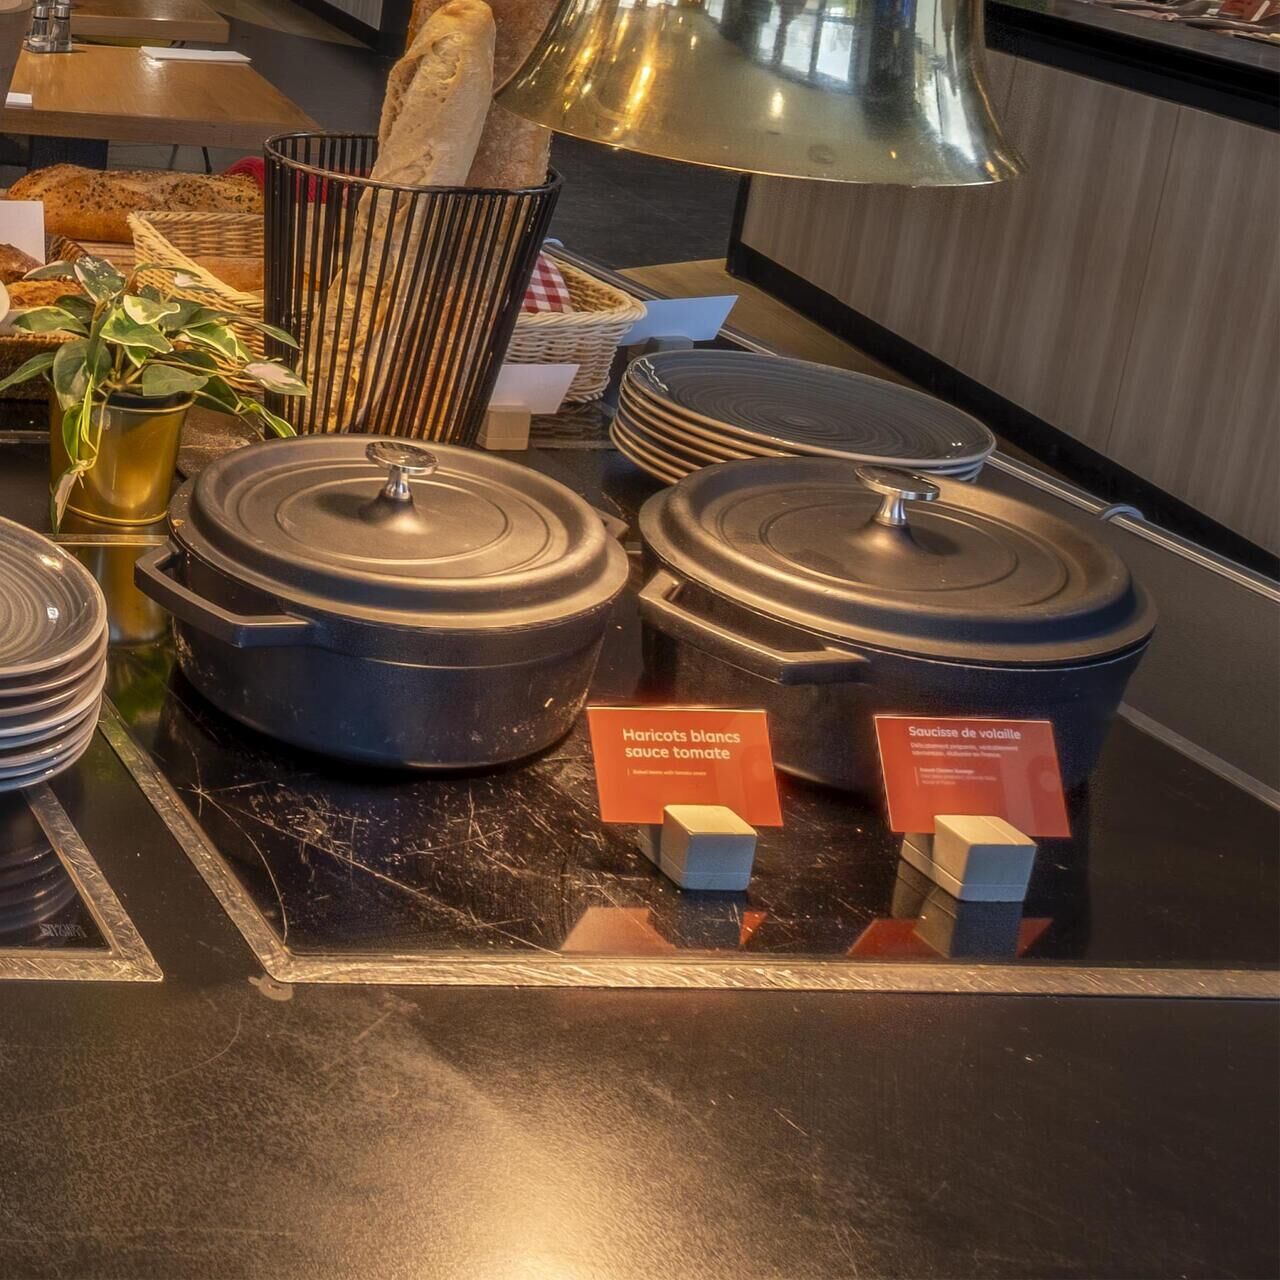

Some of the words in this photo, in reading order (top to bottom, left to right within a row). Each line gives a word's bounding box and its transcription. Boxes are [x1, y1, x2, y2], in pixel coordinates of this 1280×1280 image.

[623, 729, 687, 742] Haricots
[690, 729, 741, 743] blancs
[908, 726, 959, 738] Saucisse
[961, 728, 976, 738] de
[979, 728, 1022, 740] volaille
[625, 747, 669, 758] sauce
[672, 746, 730, 759] tomate
